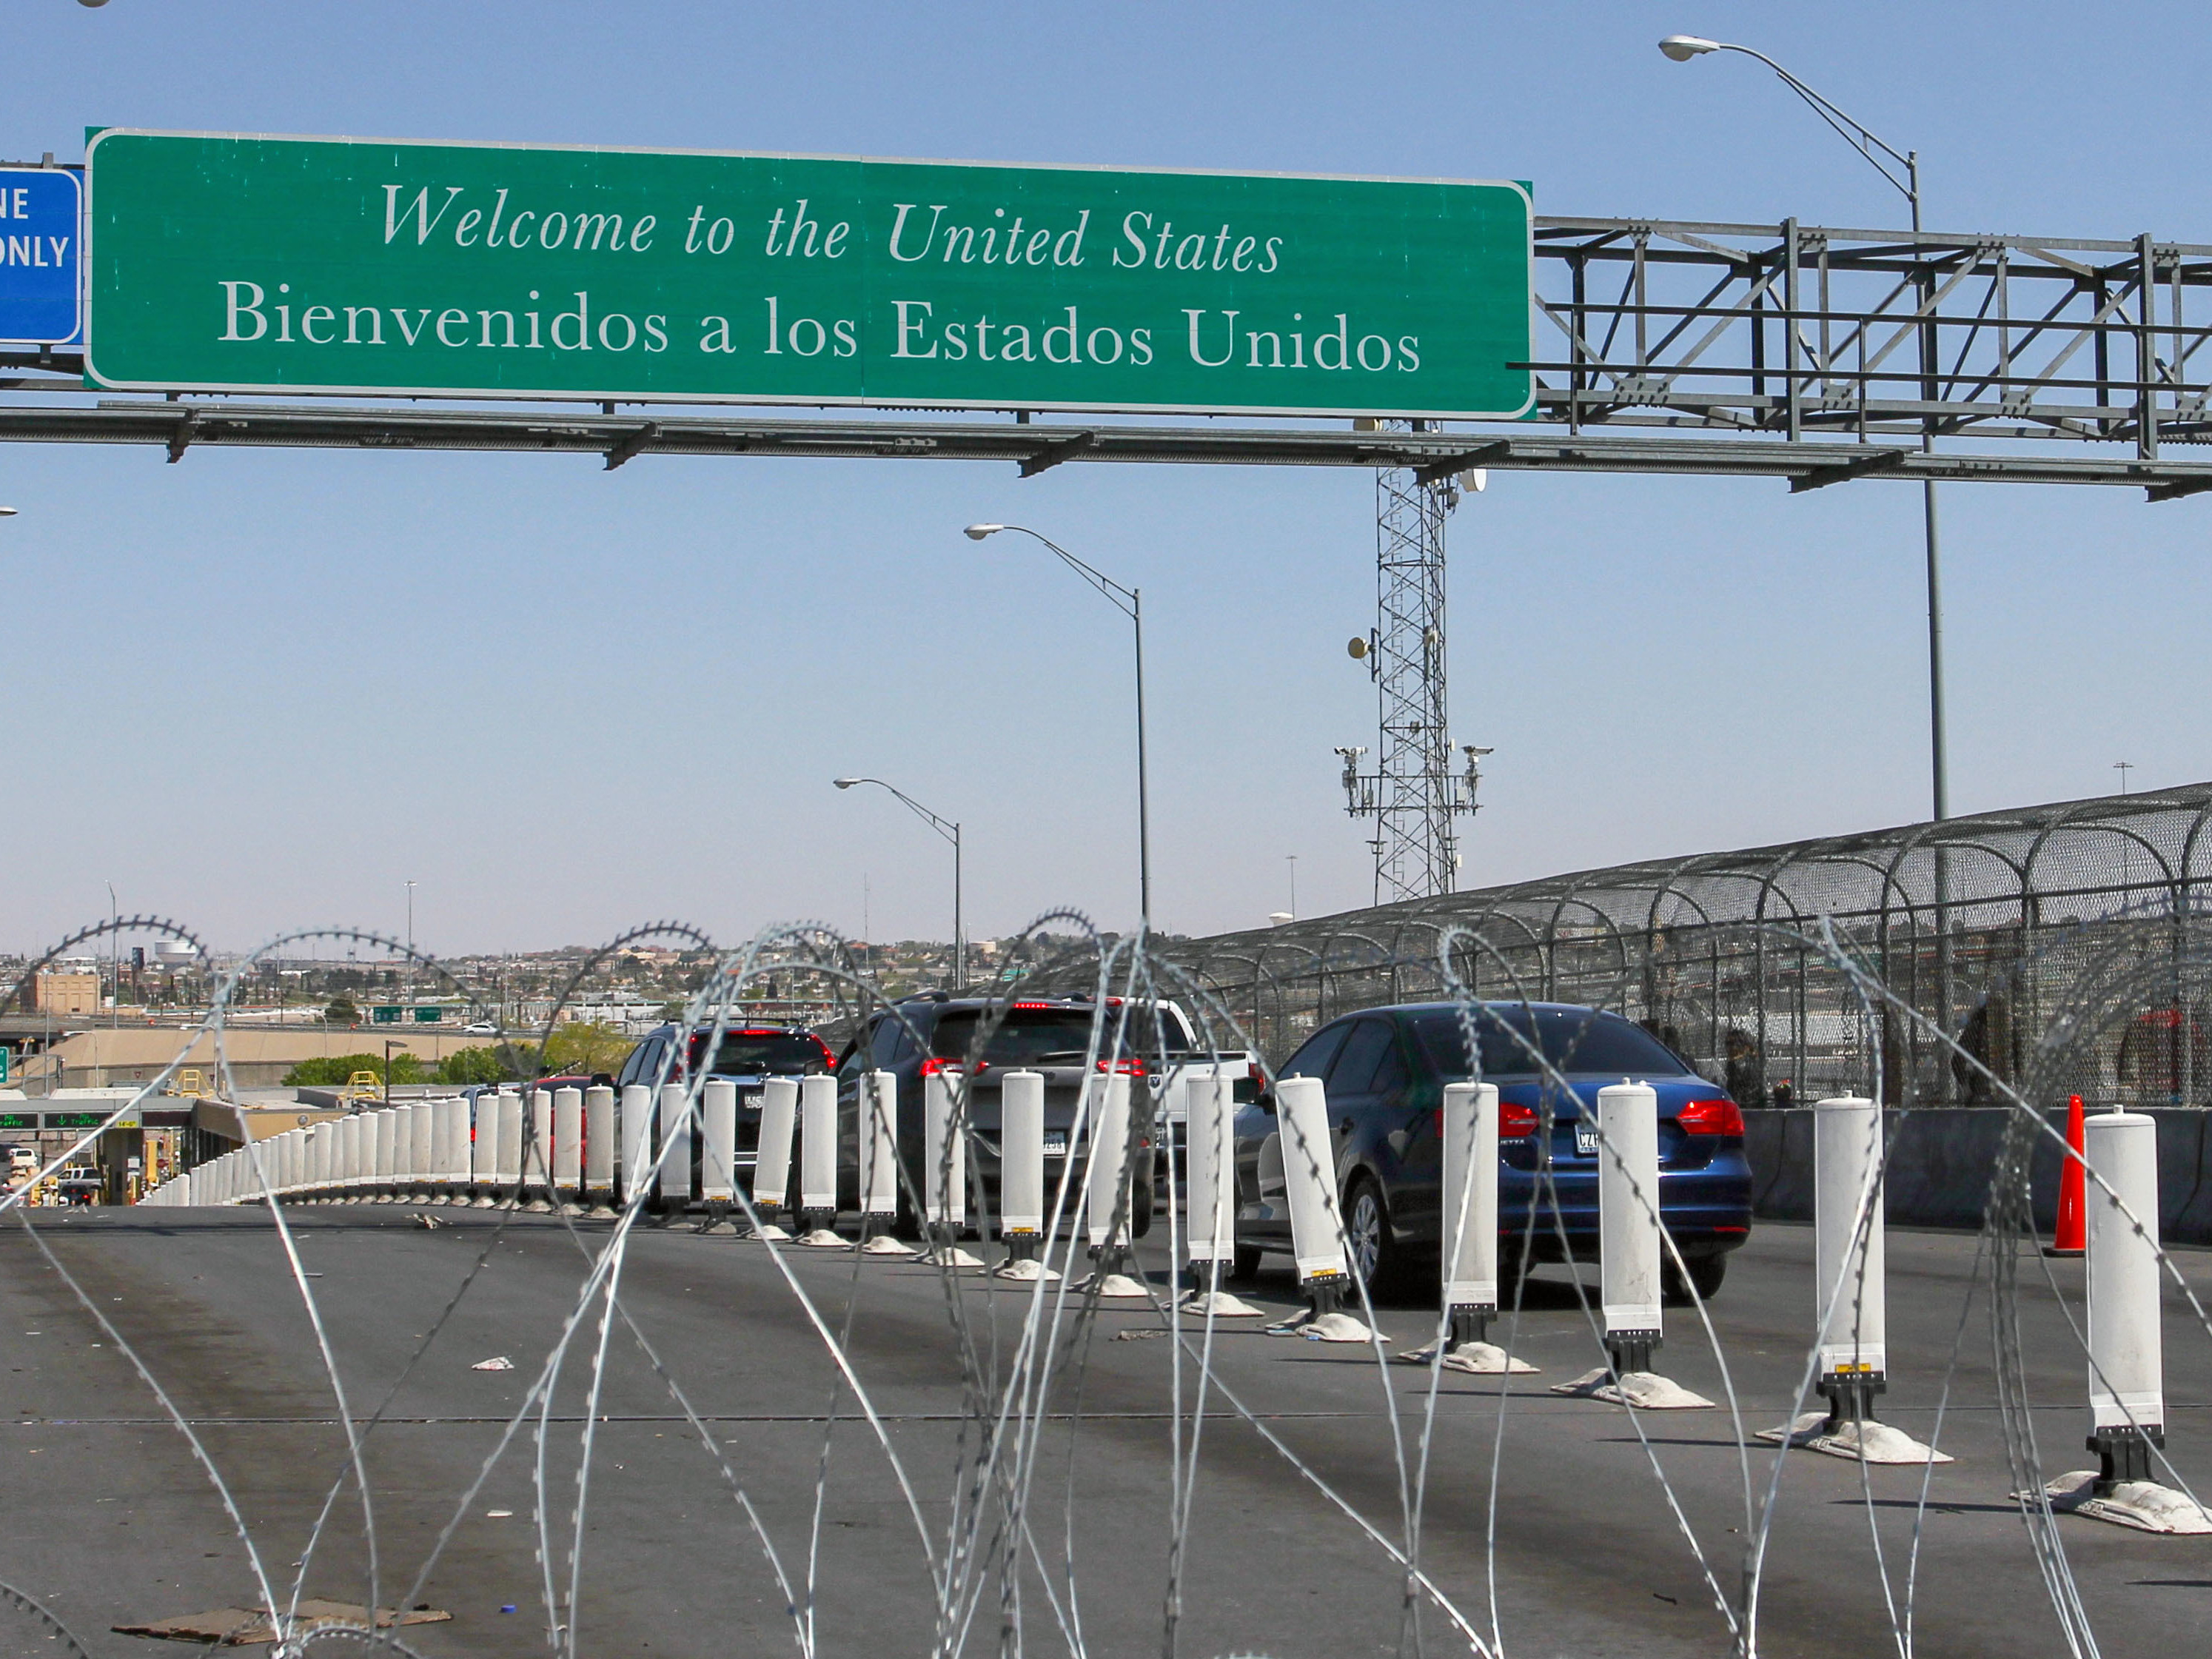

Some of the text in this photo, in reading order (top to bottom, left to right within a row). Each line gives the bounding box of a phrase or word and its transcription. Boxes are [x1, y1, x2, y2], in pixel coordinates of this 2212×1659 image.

[0, 235, 69, 267] NLY
[381, 184, 1283, 273] Welcome to the United States
[218, 281, 1420, 372] Bienvenidos a los Estados Unidos
